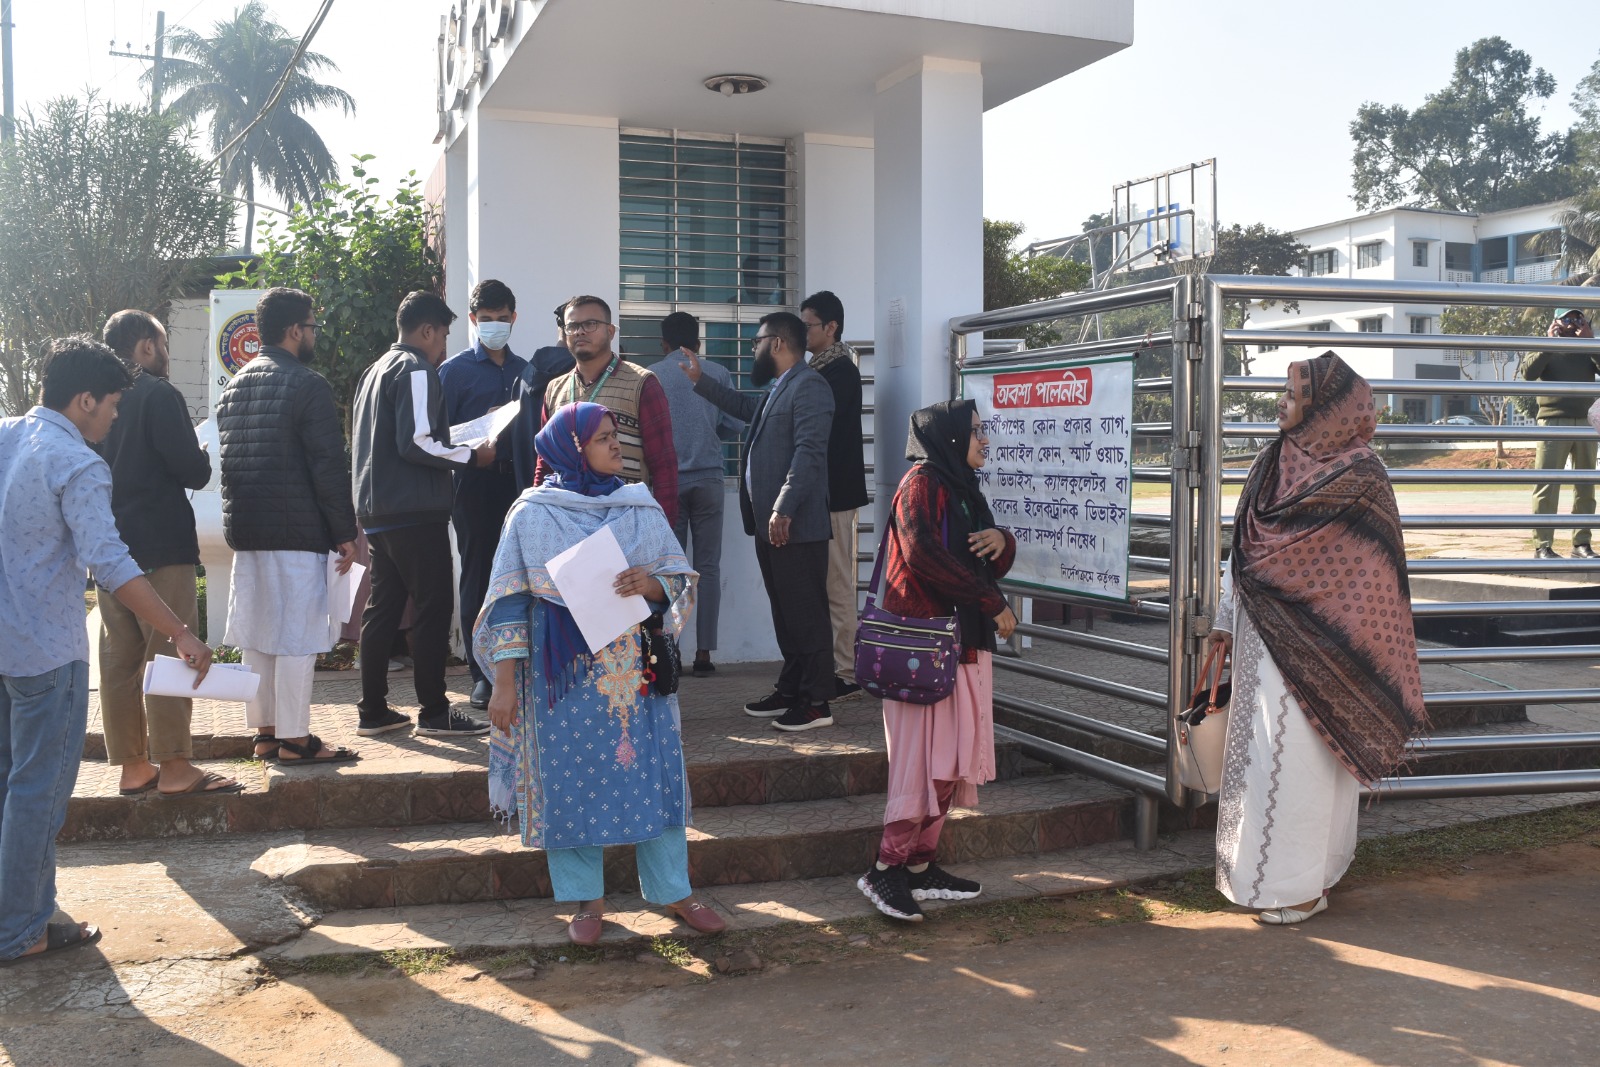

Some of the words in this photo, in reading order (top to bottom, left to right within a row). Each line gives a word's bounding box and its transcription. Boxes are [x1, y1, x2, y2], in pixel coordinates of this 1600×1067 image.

[996, 382, 1032, 406] অবশ্য
[1035, 371, 1088, 405] পালনীয়
[982, 414, 1025, 435] ক্ষার্থীগণের
[1033, 417, 1056, 435] কোন
[1064, 416, 1092, 435] প্রকার
[1100, 414, 1129, 438] ব্যাগ,
[996, 440, 1034, 464] মোবাইল
[1038, 444, 1065, 467] ফোন,
[1069, 440, 1094, 464] স্মার্ট
[1096, 444, 1128, 468] ওয়াচ,
[997, 467, 1036, 492] ডিভাইস,
[1043, 469, 1107, 497] ক্যালকুলেটর
[1115, 475, 1128, 495] বা
[992, 498, 1018, 515] ধরনের
[1084, 498, 1128, 526] ডিভাইস
[1014, 526, 1031, 543] করা
[1035, 525, 1065, 552] সম্পূর্ণ
[1066, 526, 1096, 551] নিষেধ
